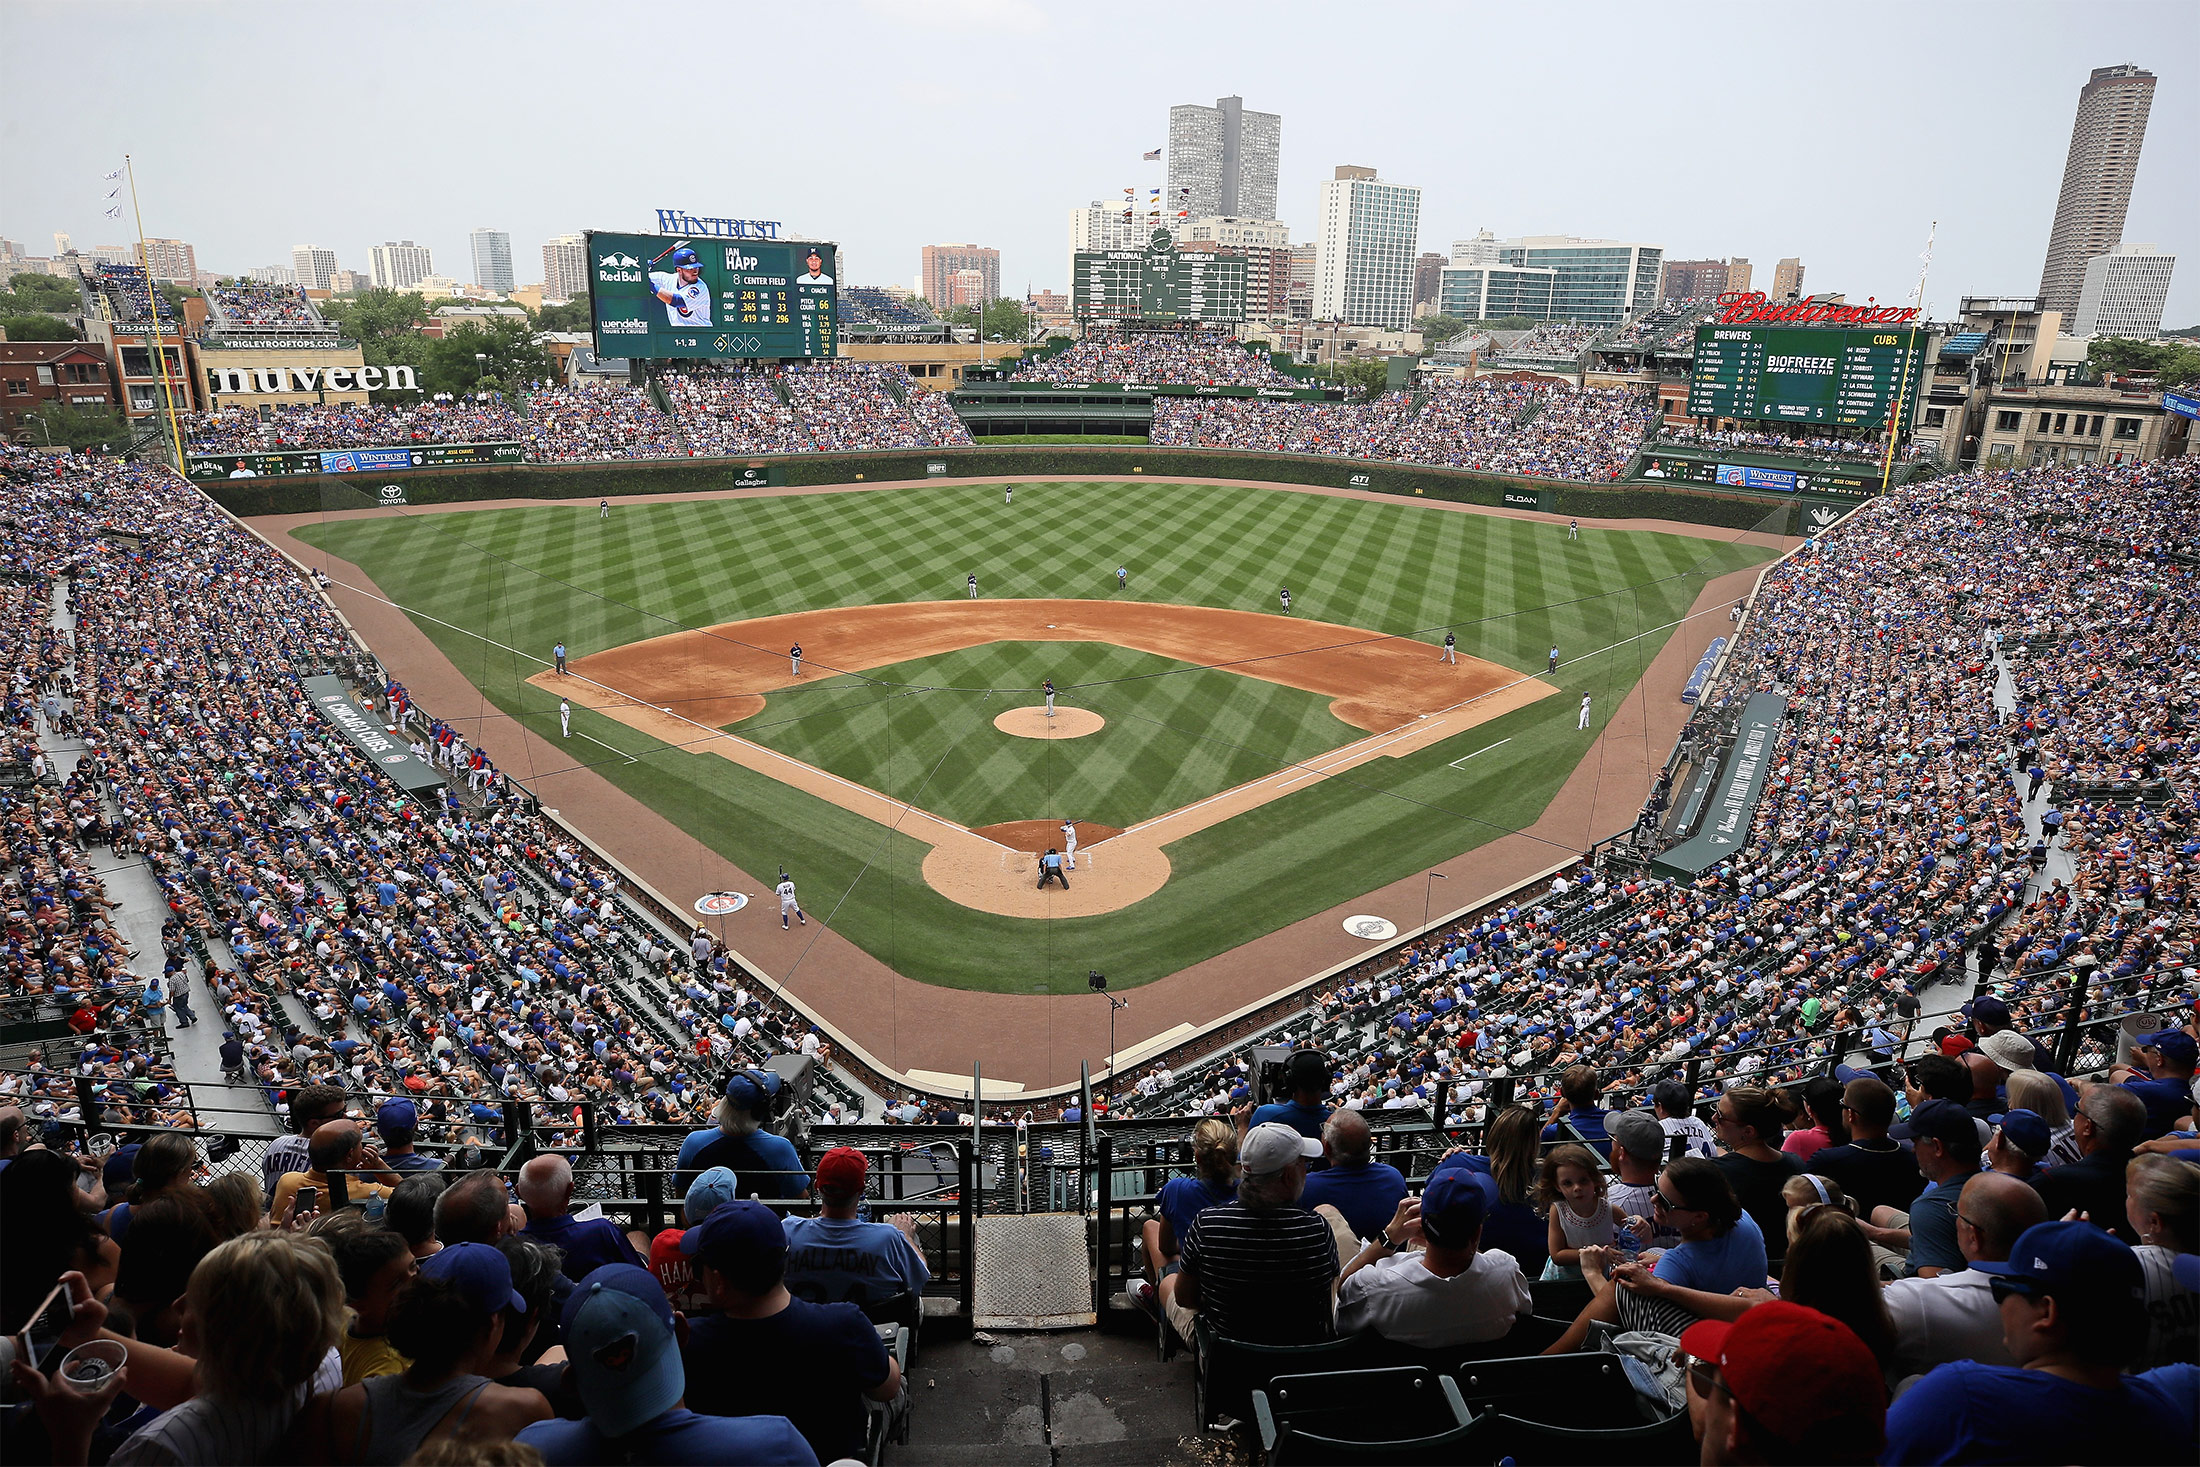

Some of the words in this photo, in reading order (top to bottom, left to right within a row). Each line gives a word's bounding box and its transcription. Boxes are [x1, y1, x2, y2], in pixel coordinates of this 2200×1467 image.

[655, 209, 782, 239] WINTRUST
[725, 247, 739, 256] IAN
[1107, 252, 1143, 260] NATIONAL
[1179, 253, 1215, 261] AMERICAN
[726, 256, 758, 271] HAPP
[600, 270, 620, 282] Red
[621, 271, 642, 283] Bull
[733, 273, 741, 285] 8
[743, 276, 768, 286] CENTER
[768, 276, 786, 286] FIELD
[722, 291, 734, 299] AVG
[740, 291, 756, 300] .243
[777, 292, 786, 300] 12
[740, 302, 756, 312] .365
[777, 303, 787, 312] 33
[819, 300, 829, 309] 66
[1718, 292, 1922, 324] Budweiser
[741, 314, 757, 323] .419
[776, 315, 789, 323] 296
[1714, 330, 1752, 341] BREWERS
[1873, 335, 1898, 345] CUBS
[223, 340, 338, 348] WRIGLEYROOFTOPS.COM
[1767, 355, 1837, 370] BIOFREEZE
[212, 365, 419, 393] nuveen
[1203, 386, 1220, 394] pepsi
[1256, 388, 1295, 398] Budweiser
[139, 401, 150, 409] W
[1764, 404, 1771, 414] 6
[1816, 407, 1824, 418] 5
[359, 452, 407, 461] WINTRUST
[493, 446, 521, 457] xfinity
[190, 462, 203, 475] JIM
[202, 460, 224, 474] BEAM
[1349, 475, 1370, 484] ATI
[1750, 469, 1794, 482] WINTRUST
[734, 478, 767, 487] Gallagher
[379, 497, 407, 505] TOYOTA
[1505, 493, 1537, 504] SLOAN
[326, 703, 372, 732] CHICAGO
[783, 887, 793, 895] 44
[788, 1248, 881, 1277] HALLADAY
